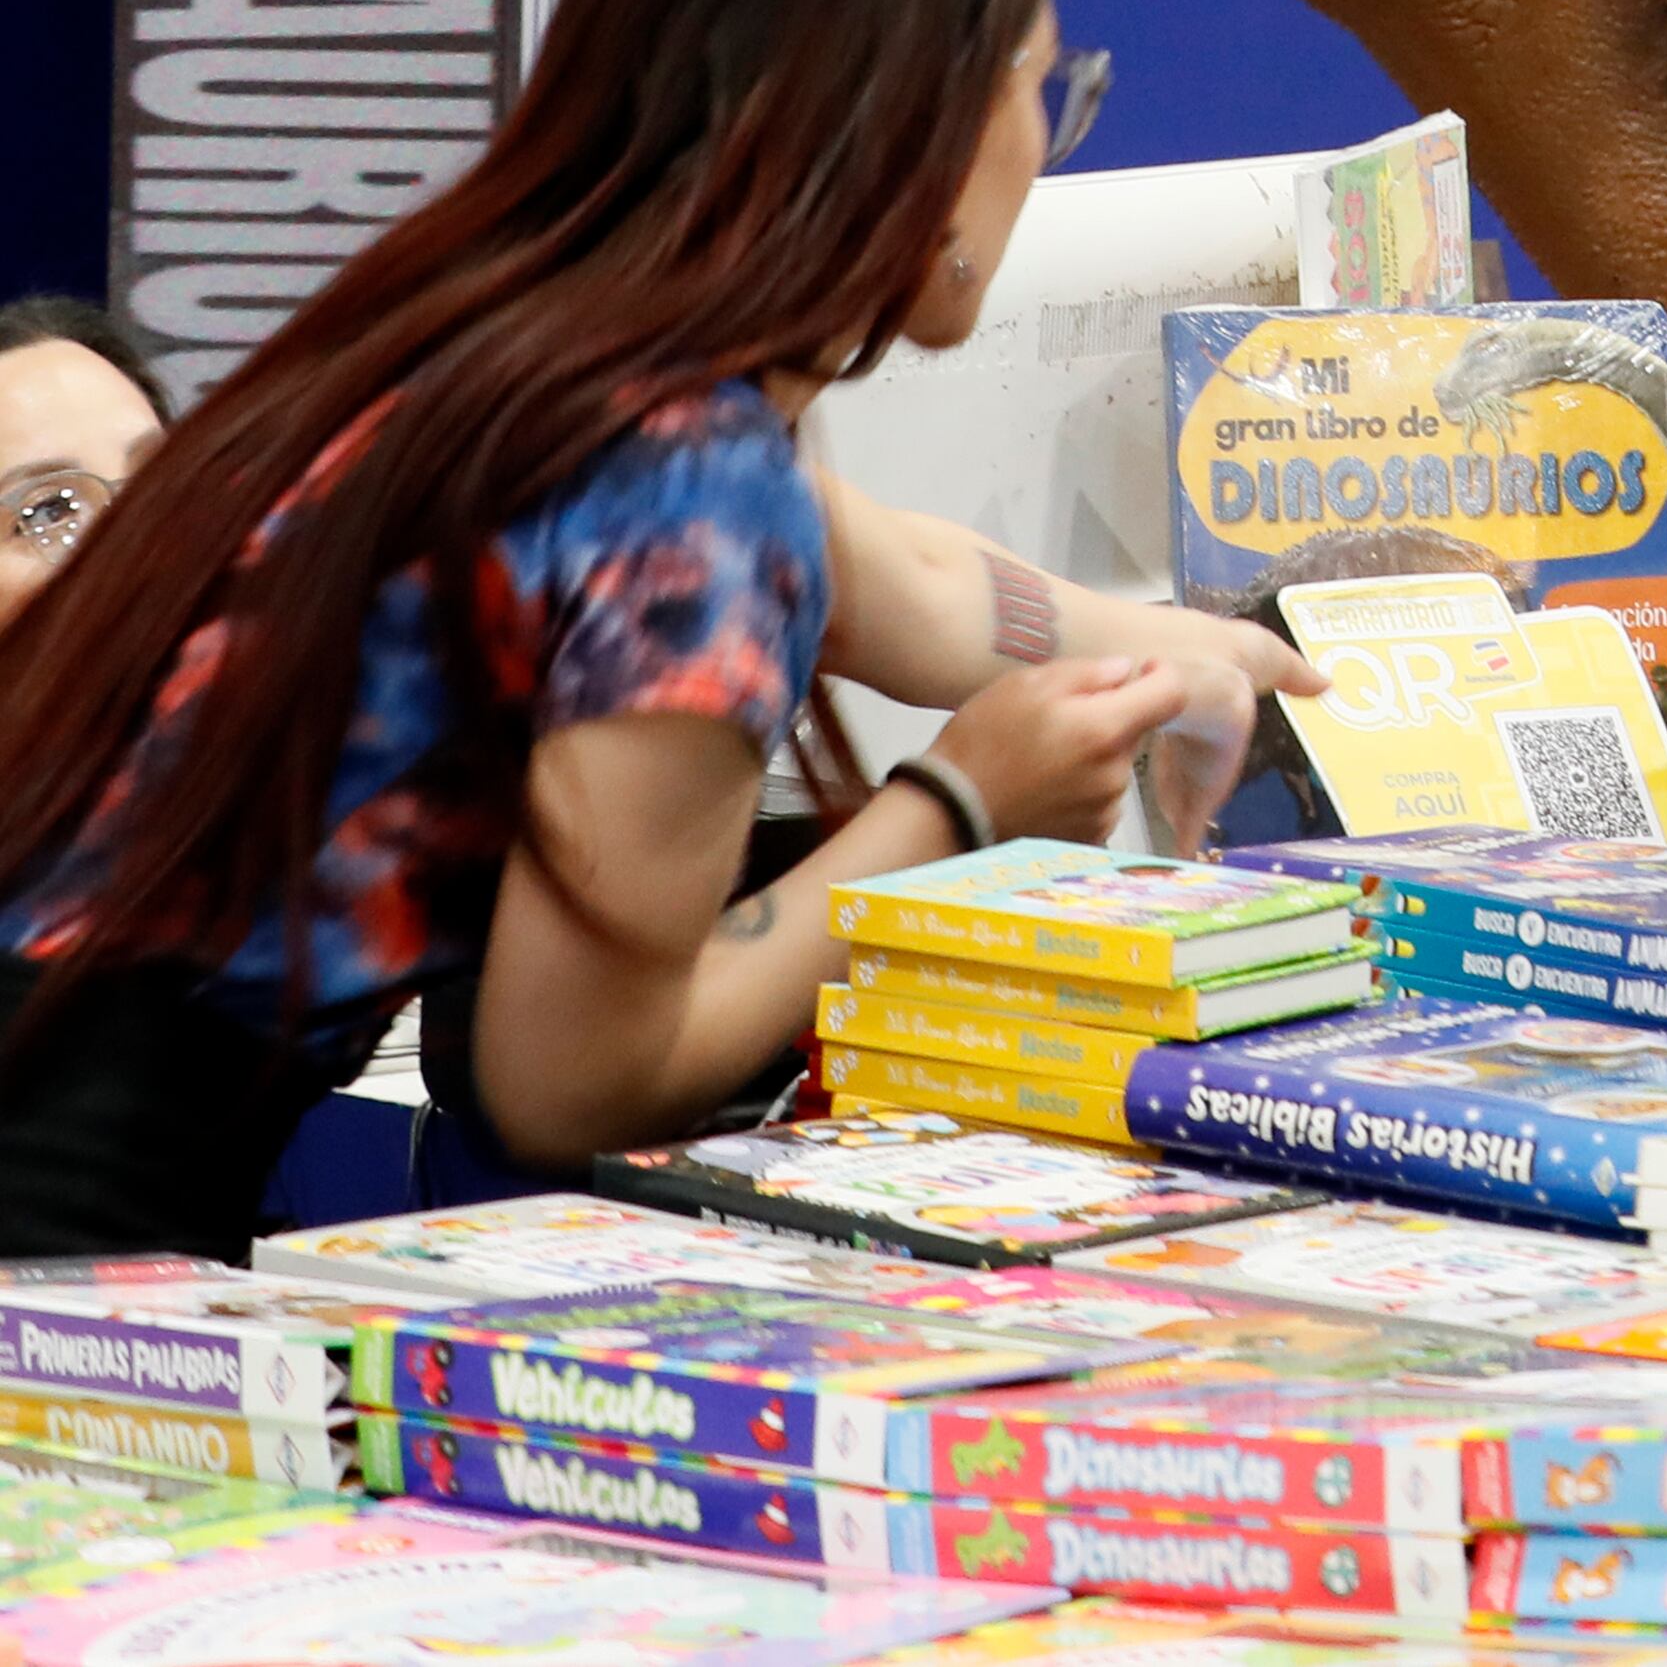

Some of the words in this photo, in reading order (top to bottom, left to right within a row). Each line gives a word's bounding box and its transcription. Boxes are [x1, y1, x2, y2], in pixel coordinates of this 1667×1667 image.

[1301, 356, 1351, 397] Mi
[1214, 411, 1298, 451] gran
[1396, 404, 1441, 440] de
[1209, 448, 1649, 526] DINOSAURIOS
[1310, 600, 1458, 634] TERRITORIO
[1316, 640, 1470, 725] QR
[1383, 770, 1460, 788] COMPRA
[1393, 784, 1468, 820] AQUÍ
[1347, 1108, 1535, 1184] Historias
[19, 1318, 131, 1382] PRIMERAS
[130, 1336, 240, 1395] PALABRAS
[46, 1404, 230, 1475] CONTANDO
[1042, 1425, 1286, 1505] Dinosaurios
[1046, 1515, 1292, 1594] Dinosaurios
